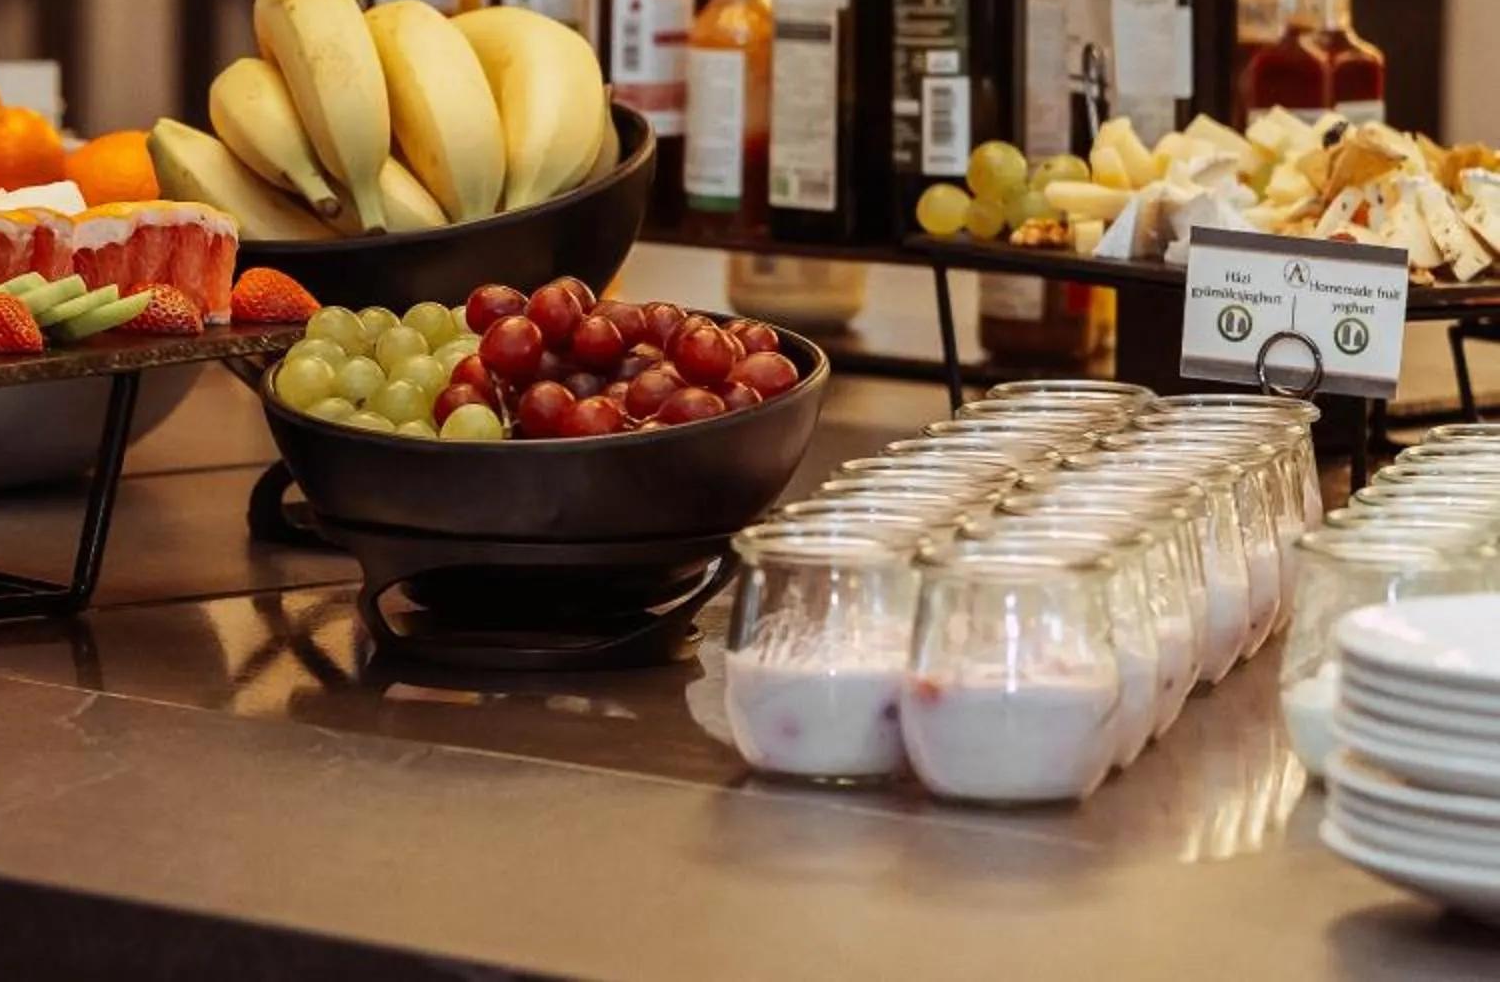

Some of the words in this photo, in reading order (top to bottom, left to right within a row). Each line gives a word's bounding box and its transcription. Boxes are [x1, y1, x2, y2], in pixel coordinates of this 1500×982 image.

[1309, 279, 1373, 297] Homemade
[1377, 285, 1401, 301] fruit
[1331, 302, 1376, 315] yoghurt
